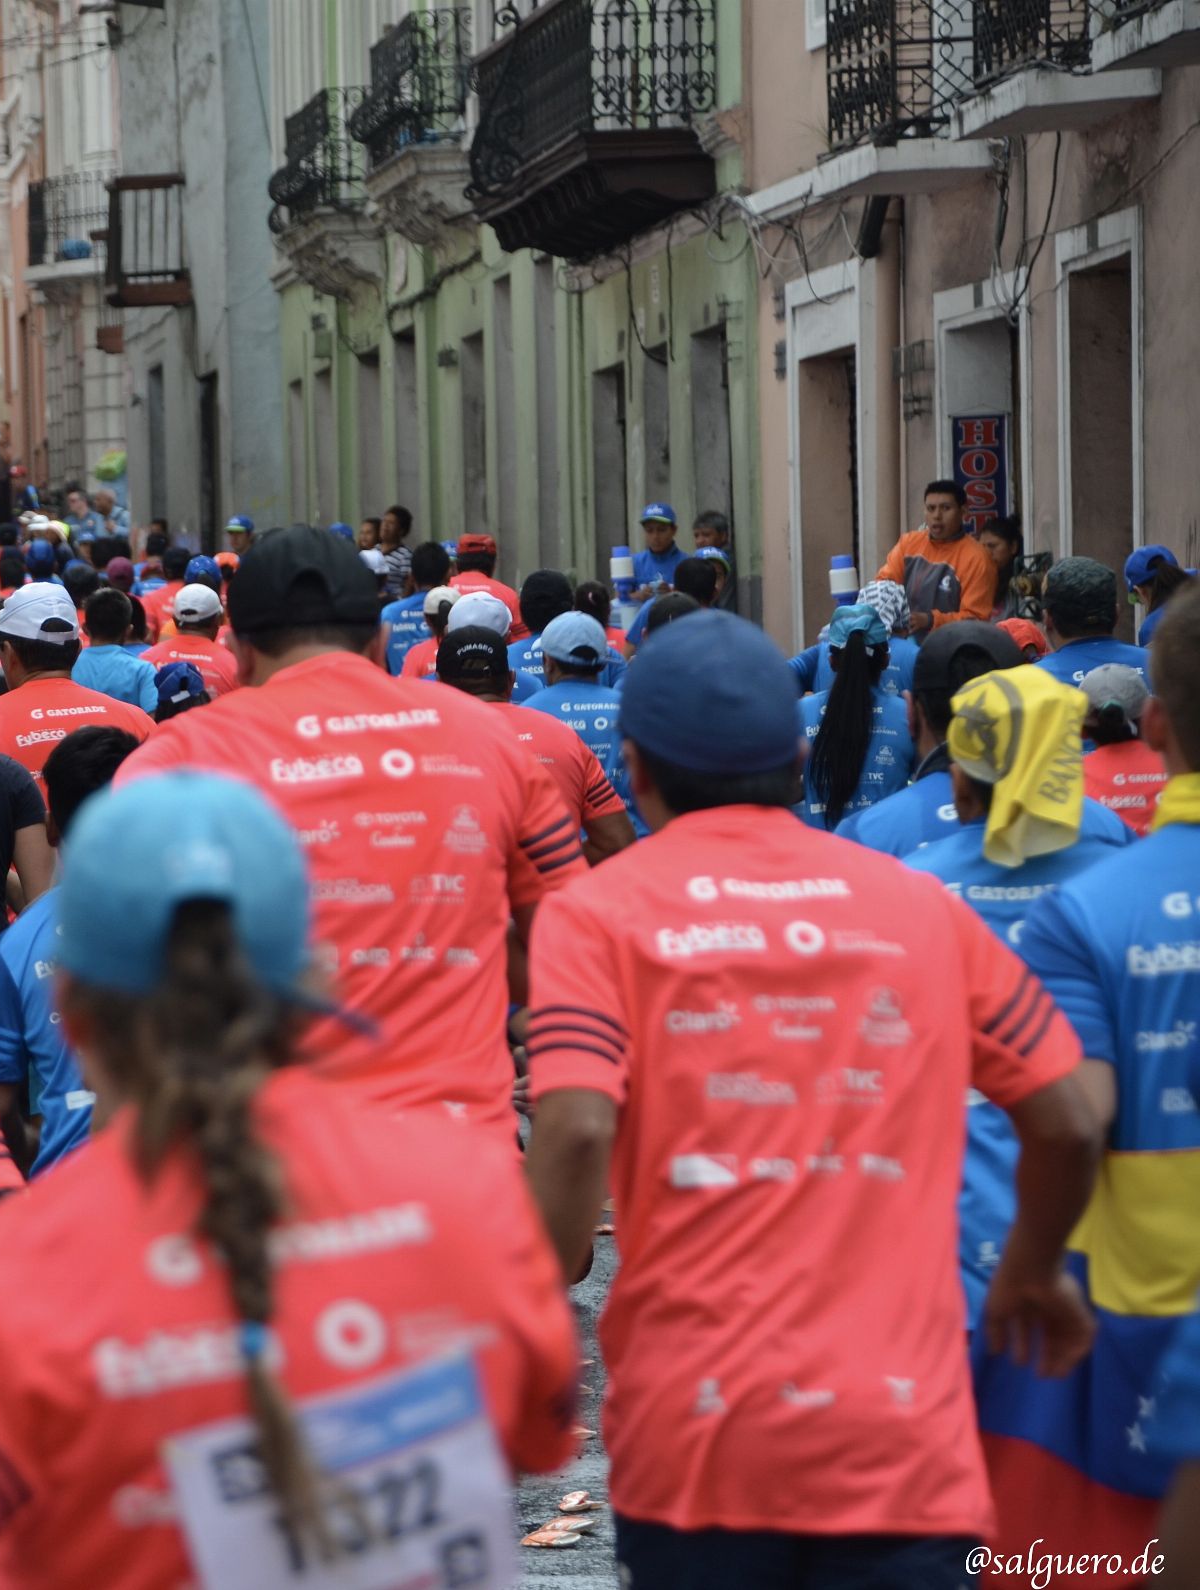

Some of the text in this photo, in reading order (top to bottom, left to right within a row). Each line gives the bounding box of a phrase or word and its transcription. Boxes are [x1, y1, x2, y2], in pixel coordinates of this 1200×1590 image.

[46, 706, 107, 717] GATORADE
[325, 708, 441, 733] GATORADE
[270, 754, 365, 784] Fybeca
[722, 878, 850, 898] GATORADE
